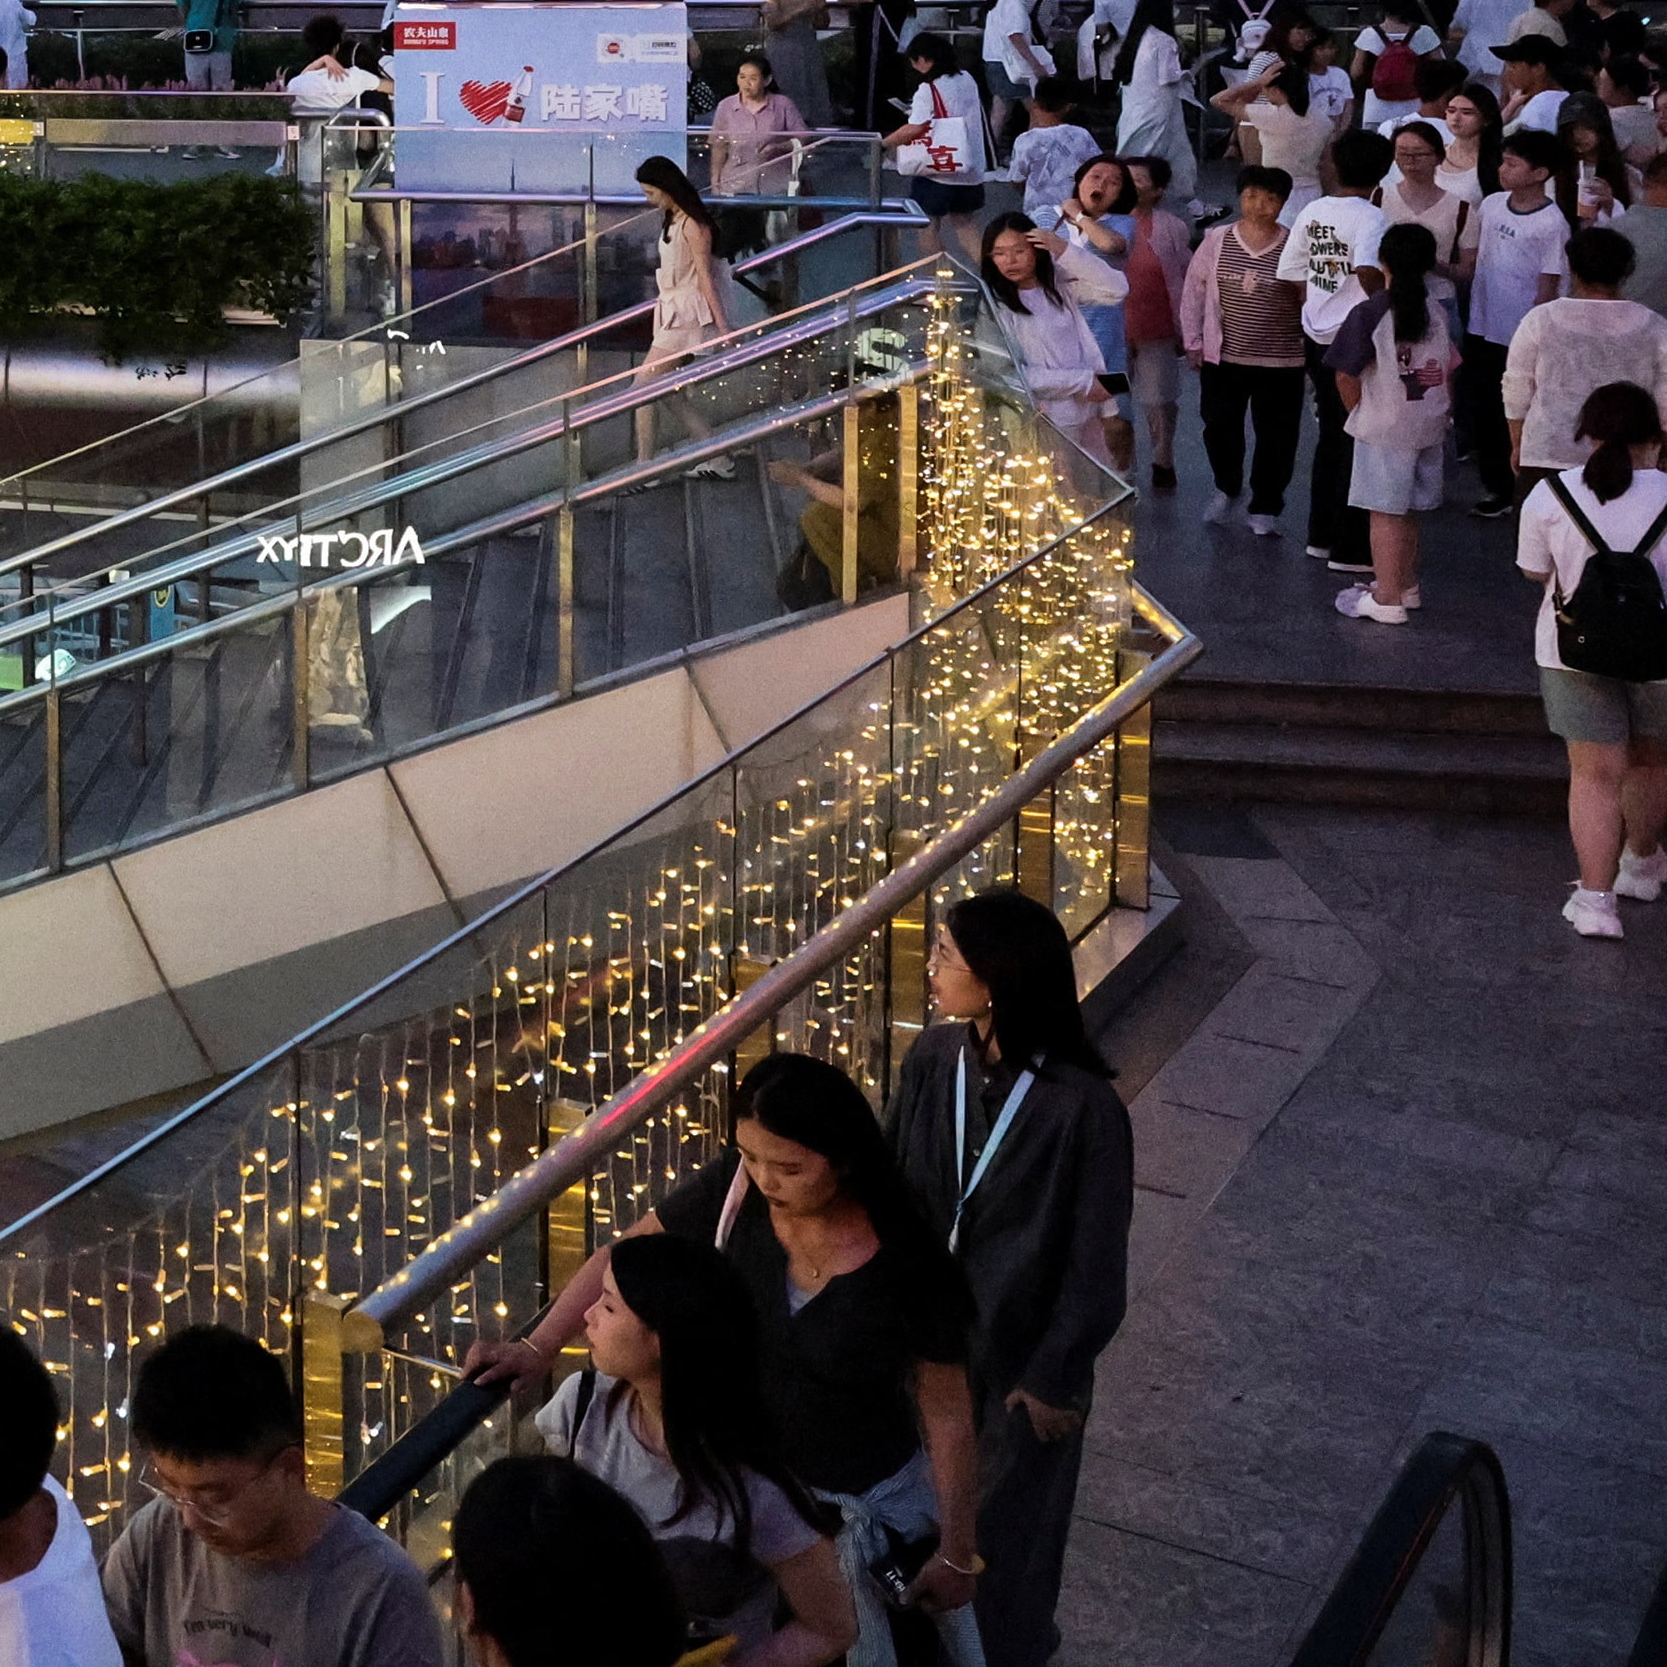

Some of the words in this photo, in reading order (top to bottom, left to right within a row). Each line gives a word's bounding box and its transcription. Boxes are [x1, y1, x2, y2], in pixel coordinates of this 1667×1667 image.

[419, 72, 446, 125] I
[541, 83, 668, 123] 陆家嘴
